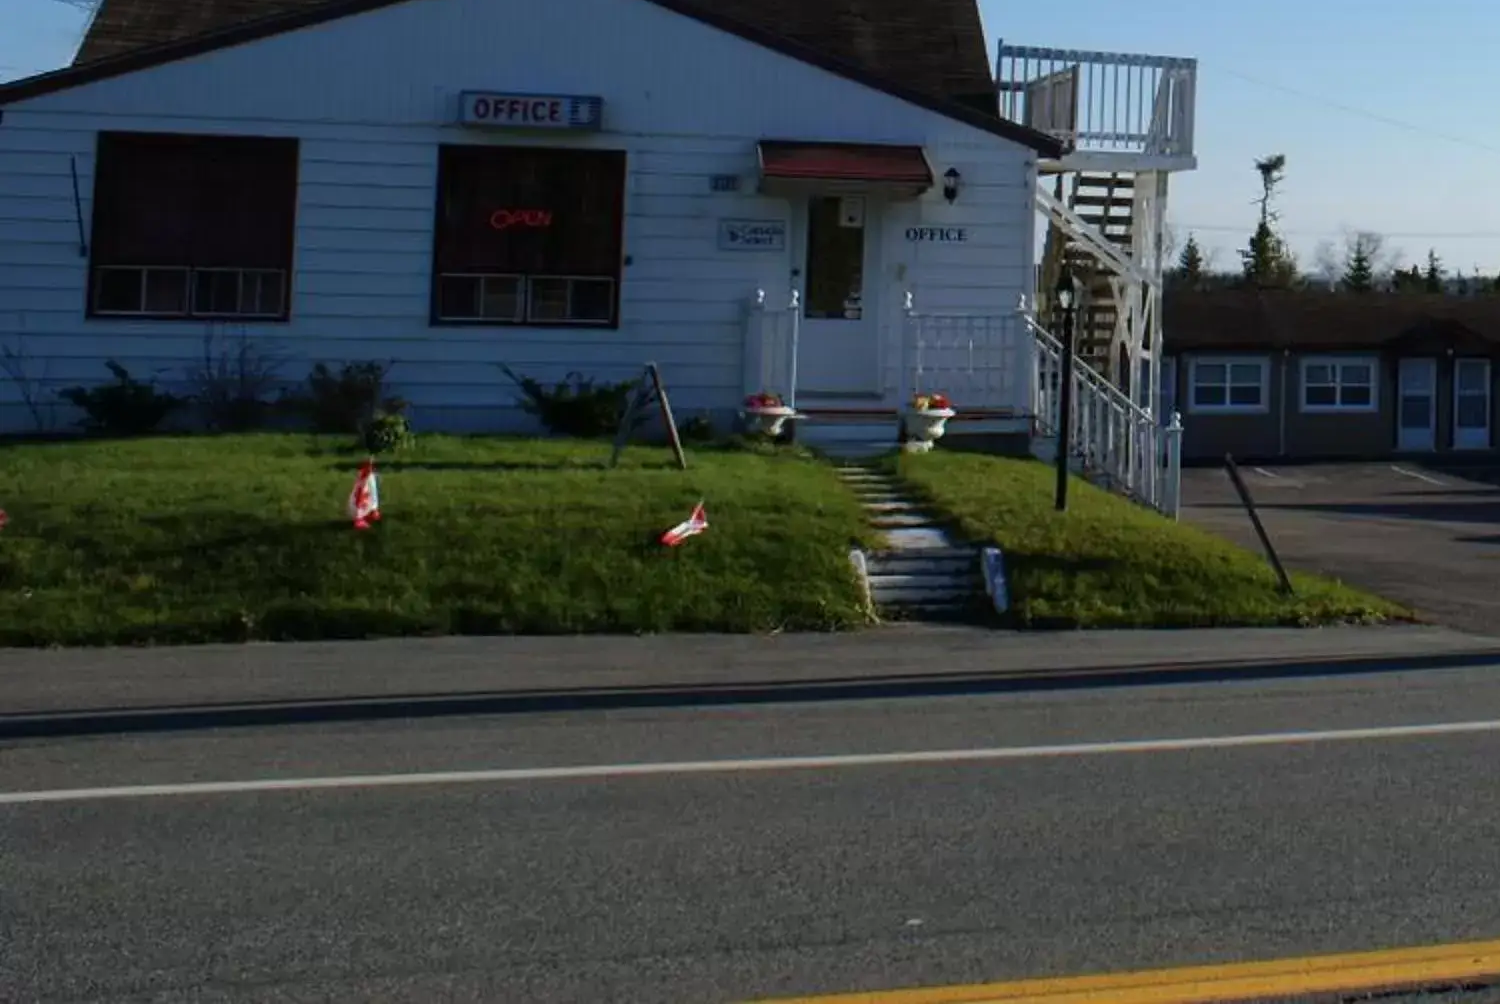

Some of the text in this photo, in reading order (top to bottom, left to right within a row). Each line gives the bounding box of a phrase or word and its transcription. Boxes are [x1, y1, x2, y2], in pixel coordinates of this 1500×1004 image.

[475, 98, 561, 122] OFFICE
[490, 210, 552, 229] OPEN
[905, 227, 969, 242] OFFICE
